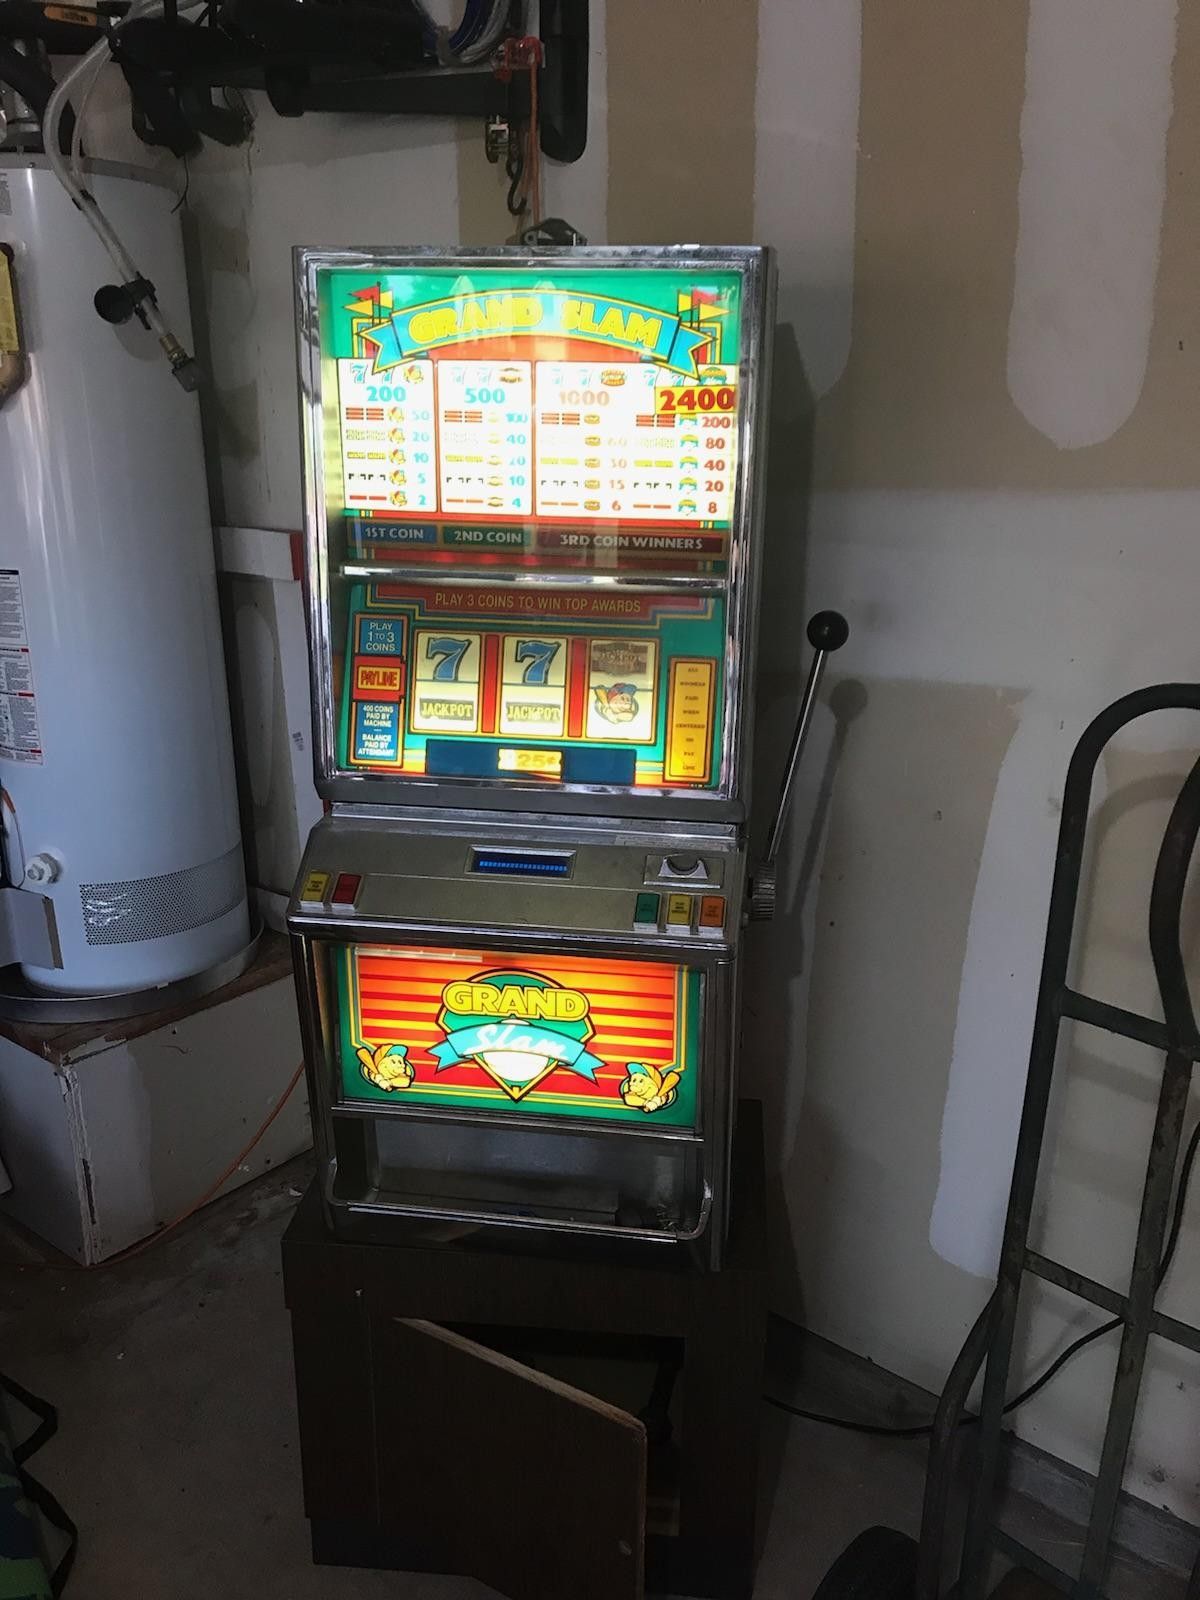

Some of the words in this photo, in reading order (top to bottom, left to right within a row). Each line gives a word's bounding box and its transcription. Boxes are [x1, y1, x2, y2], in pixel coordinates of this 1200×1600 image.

[408, 297, 544, 344] GRAND
[561, 300, 663, 349] SLAM
[367, 386, 406, 402] 200
[464, 387, 506, 404] 500
[560, 390, 610, 406] 1000
[660, 388, 736, 411] 2400
[412, 411, 430, 421] 50
[702, 416, 731, 428] 200
[412, 432, 430, 442] 20
[507, 434, 526, 445] 40
[706, 438, 725, 450] 80
[413, 453, 430, 463] 10
[704, 460, 725, 471] 40
[418, 474, 426, 484] 5
[509, 475, 525, 486] 10
[609, 479, 625, 490] 15
[705, 481, 724, 492] 20
[418, 495, 427, 505] 2
[512, 498, 521, 508] 4
[612, 500, 621, 511] 6
[708, 502, 717, 514] 8
[365, 528, 386, 540] 1ST
[389, 527, 424, 540] COIN
[453, 530, 484, 543] 2ND
[487, 531, 522, 544] COIN
[560, 534, 590, 546] 3RD
[593, 535, 629, 548] COIN
[632, 536, 704, 550] WINNERS
[435, 592, 464, 607] PLAY
[467, 593, 475, 607] 3
[478, 594, 514, 608] COINS
[518, 596, 534, 609] TO
[537, 597, 562, 610] WIN
[565, 598, 589, 611] TOP
[591, 599, 641, 613] AWARDS
[369, 622, 393, 630] PLAY
[368, 631, 374, 641] 1
[375, 632, 385, 640] TO
[386, 632, 395, 642] 3
[365, 642, 396, 652] COINS
[426, 637, 472, 681] 7
[515, 639, 561, 685] 7
[360, 670, 398, 687] PAYLINE
[374, 705, 394, 713] COINS
[421, 702, 473, 719] JACKPOT
[506, 705, 561, 721] JACKPOT
[366, 712, 380, 720] PAID
[381, 713, 391, 721] BY
[363, 719, 392, 728] MACHINE
[362, 733, 392, 742] BALANCE
[364, 741, 379, 749] PAID
[380, 742, 389, 750] BY
[444, 982, 587, 1019] GRAND
[464, 1023, 567, 1060] Slam
